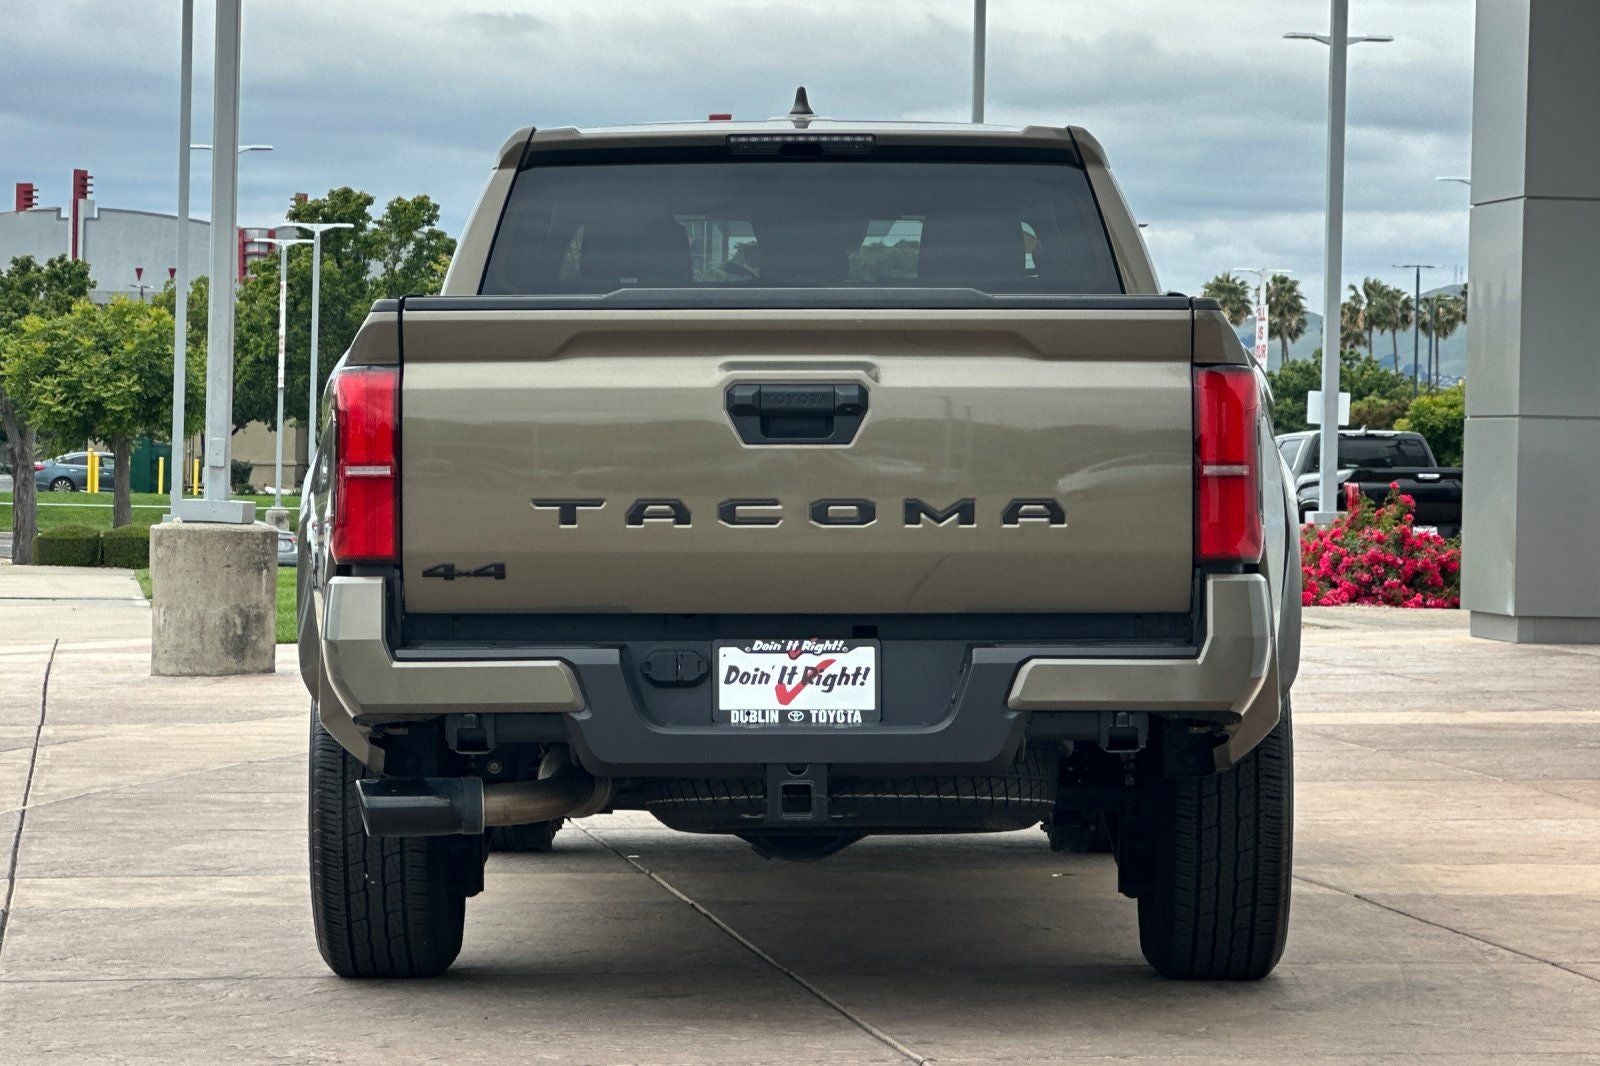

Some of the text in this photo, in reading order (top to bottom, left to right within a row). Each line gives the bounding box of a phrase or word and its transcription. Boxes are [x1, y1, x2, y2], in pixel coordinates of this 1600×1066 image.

[530, 498, 1068, 529] TACOMA
[752, 640, 845, 655] Doin' It Right!
[724, 665, 871, 693] Doin' It Right!
[730, 710, 862, 723] DUBLIN TOYOTA
